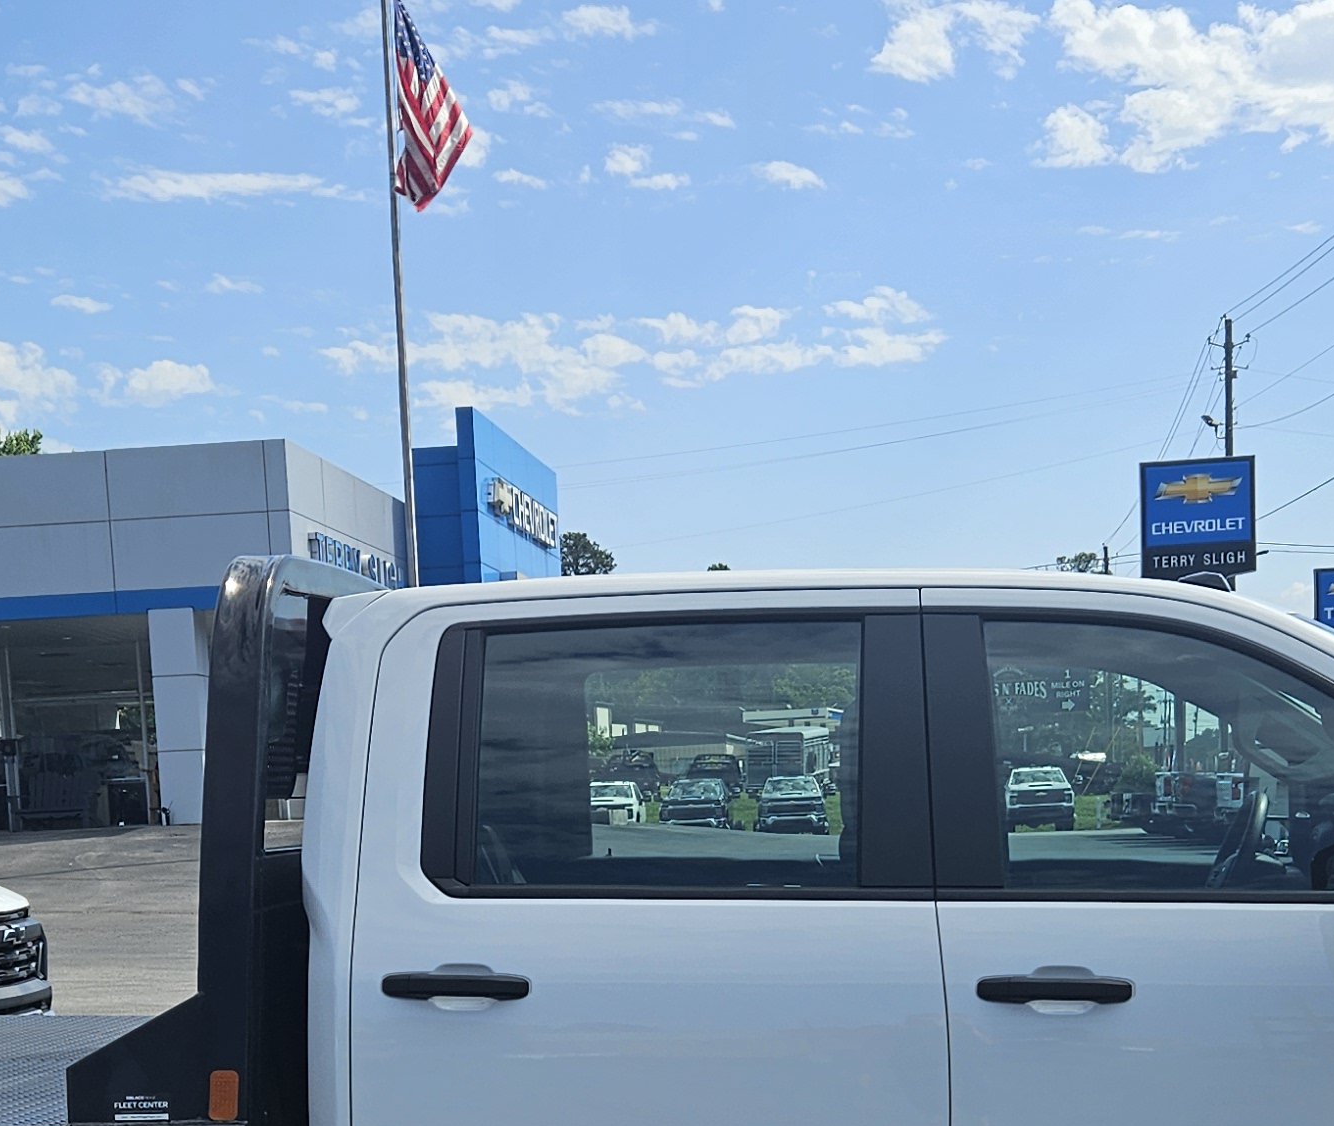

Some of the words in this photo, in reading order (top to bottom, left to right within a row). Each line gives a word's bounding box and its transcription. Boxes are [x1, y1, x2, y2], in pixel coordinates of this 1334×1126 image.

[511, 486, 558, 549] CHEVROLET
[1151, 516, 1246, 536] CHEVROLET
[1152, 554, 1196, 569] TERRY
[1203, 550, 1246, 566] SLIGH
[1064, 668, 1071, 679] 1
[1014, 680, 1047, 699] FADES
[1050, 681, 1070, 689] MILE
[1071, 679, 1085, 688] ON
[1055, 689, 1082, 698] RIGHT
[113, 1101, 137, 1109] FLEET
[138, 1100, 169, 1109] CENTER
